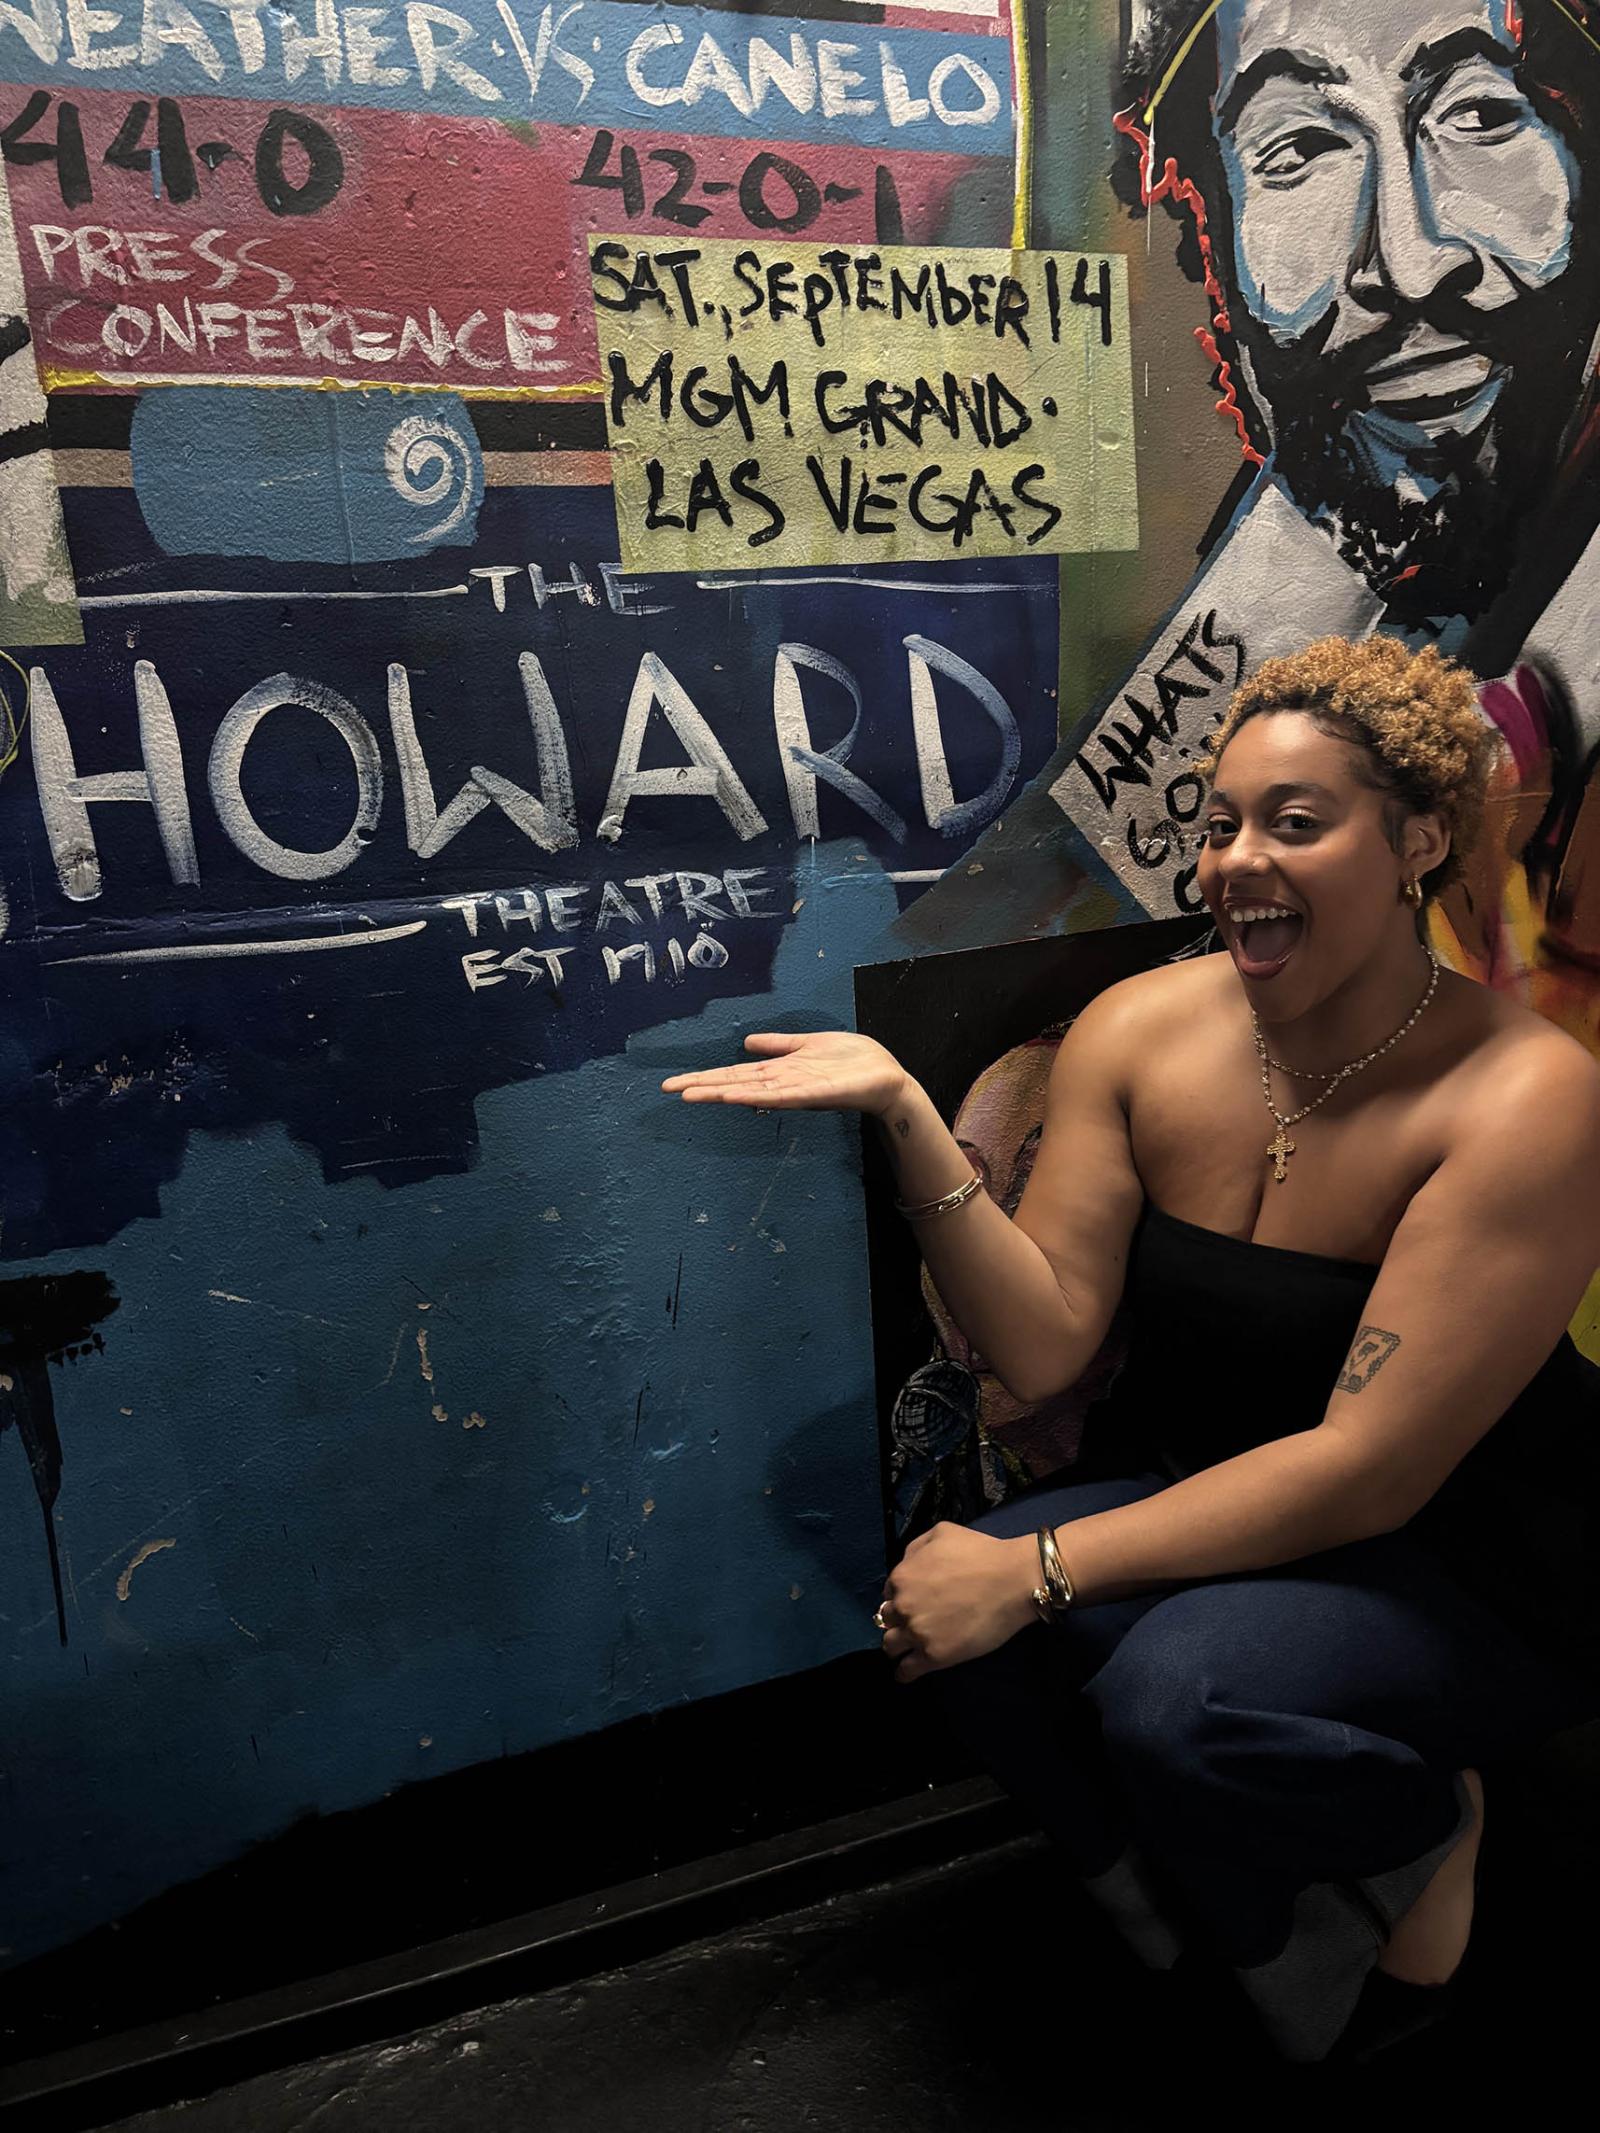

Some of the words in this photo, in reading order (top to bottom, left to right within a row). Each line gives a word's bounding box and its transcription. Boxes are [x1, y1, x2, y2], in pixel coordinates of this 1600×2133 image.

[625, 22, 1001, 127] CANELO
[0, 90, 345, 217] 44-0
[569, 128, 906, 246] 42-0-1
[29, 224, 296, 303] PRESS
[1044, 256, 1112, 346] 14
[47, 296, 578, 373] CONFERENCE
[607, 350, 794, 442] MGM
[645, 457, 787, 548] LAS
[805, 455, 1062, 547] VEGAS
[469, 563, 677, 617] THE
[29, 633, 1022, 901] HOWARD
[440, 866, 784, 938] THEATRE
[460, 944, 576, 994] EST
